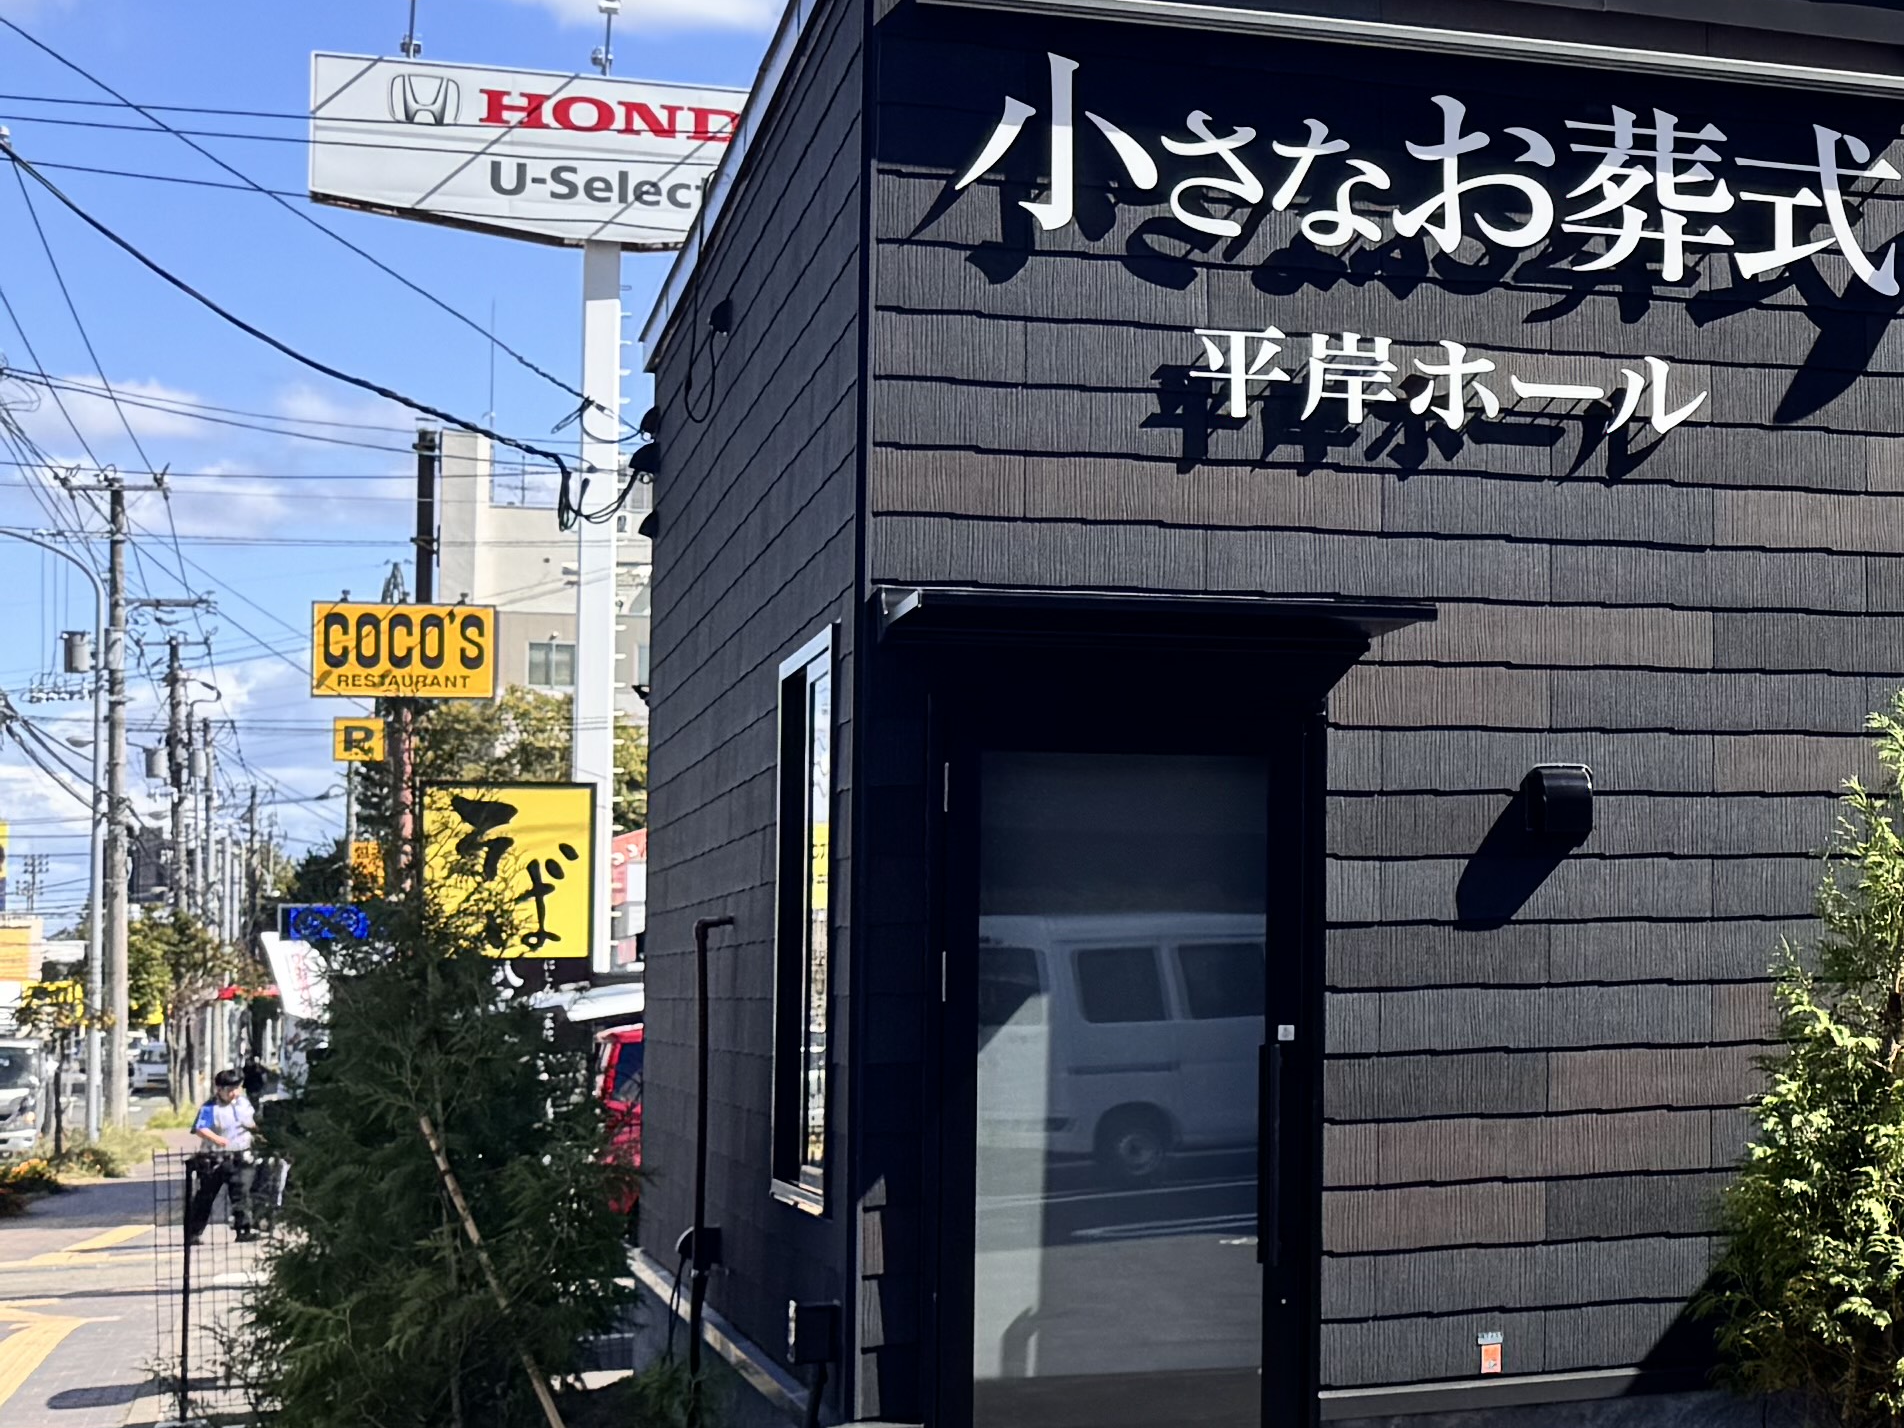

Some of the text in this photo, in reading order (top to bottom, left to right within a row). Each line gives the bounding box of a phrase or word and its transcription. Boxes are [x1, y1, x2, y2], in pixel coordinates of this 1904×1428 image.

[479, 88, 740, 143] HOND
[490, 160, 710, 210] U-Selec
[954, 51, 1902, 297] 小さなお葬式
[1188, 325, 1708, 435] 平岸ホール
[323, 611, 485, 670] COCO'S
[337, 674, 471, 689] RESTAURANT
